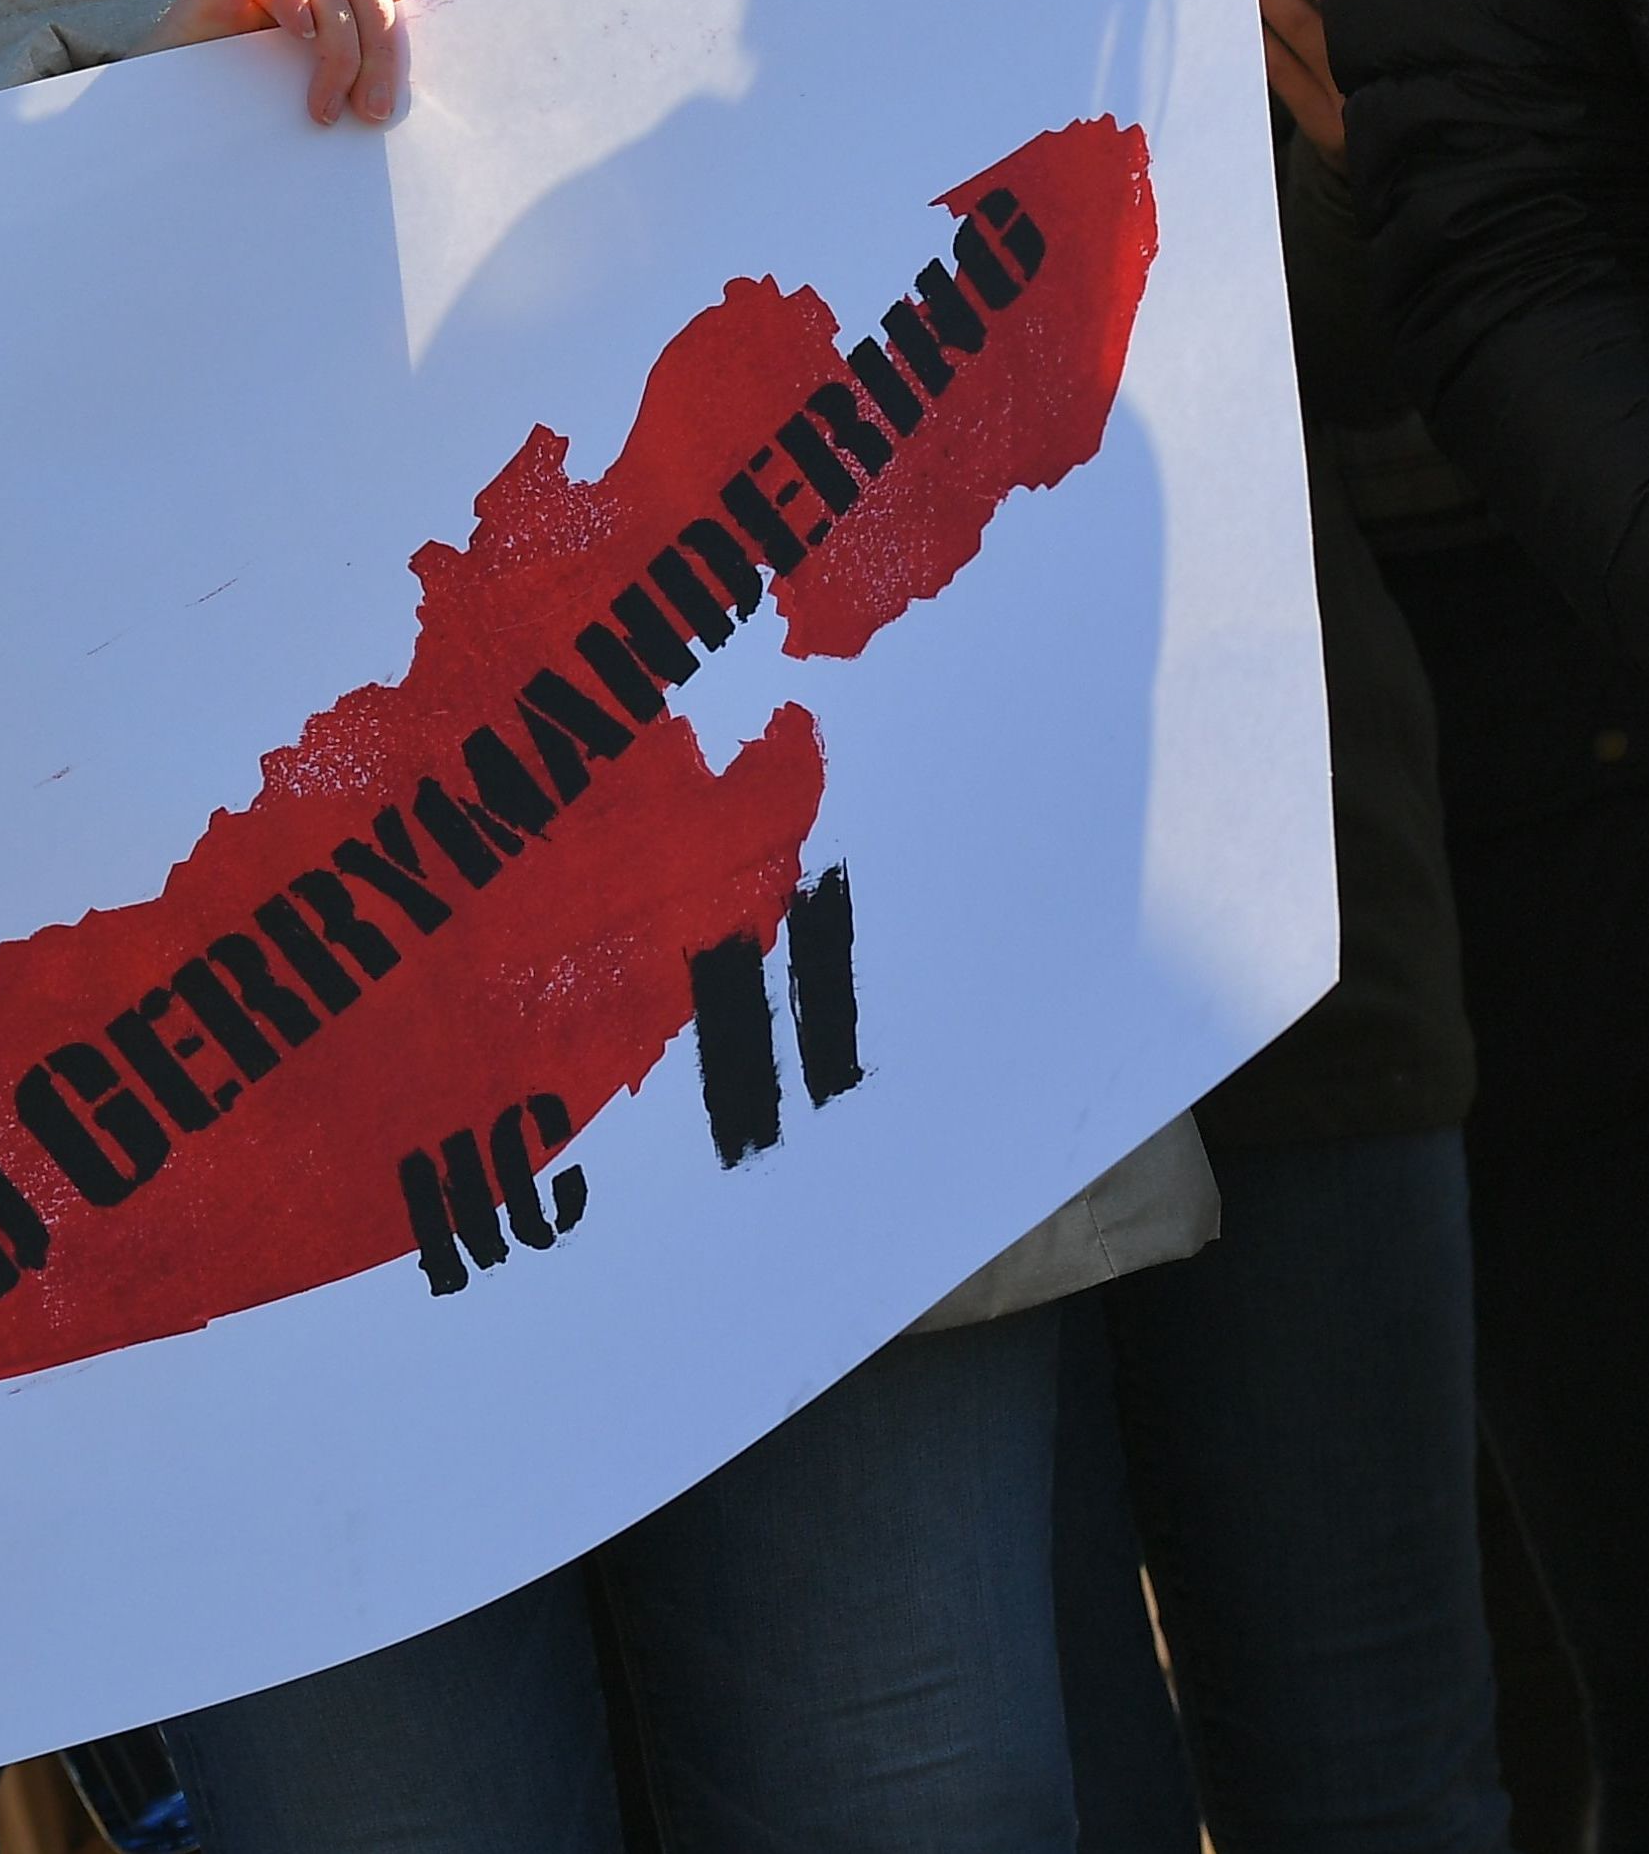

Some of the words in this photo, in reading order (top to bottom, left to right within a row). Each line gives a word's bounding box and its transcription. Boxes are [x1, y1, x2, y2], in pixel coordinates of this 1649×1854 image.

[13, 187, 1047, 1209] GERRYMANDERING
[397, 1092, 589, 1296] NC
[683, 858, 866, 1170] 11
